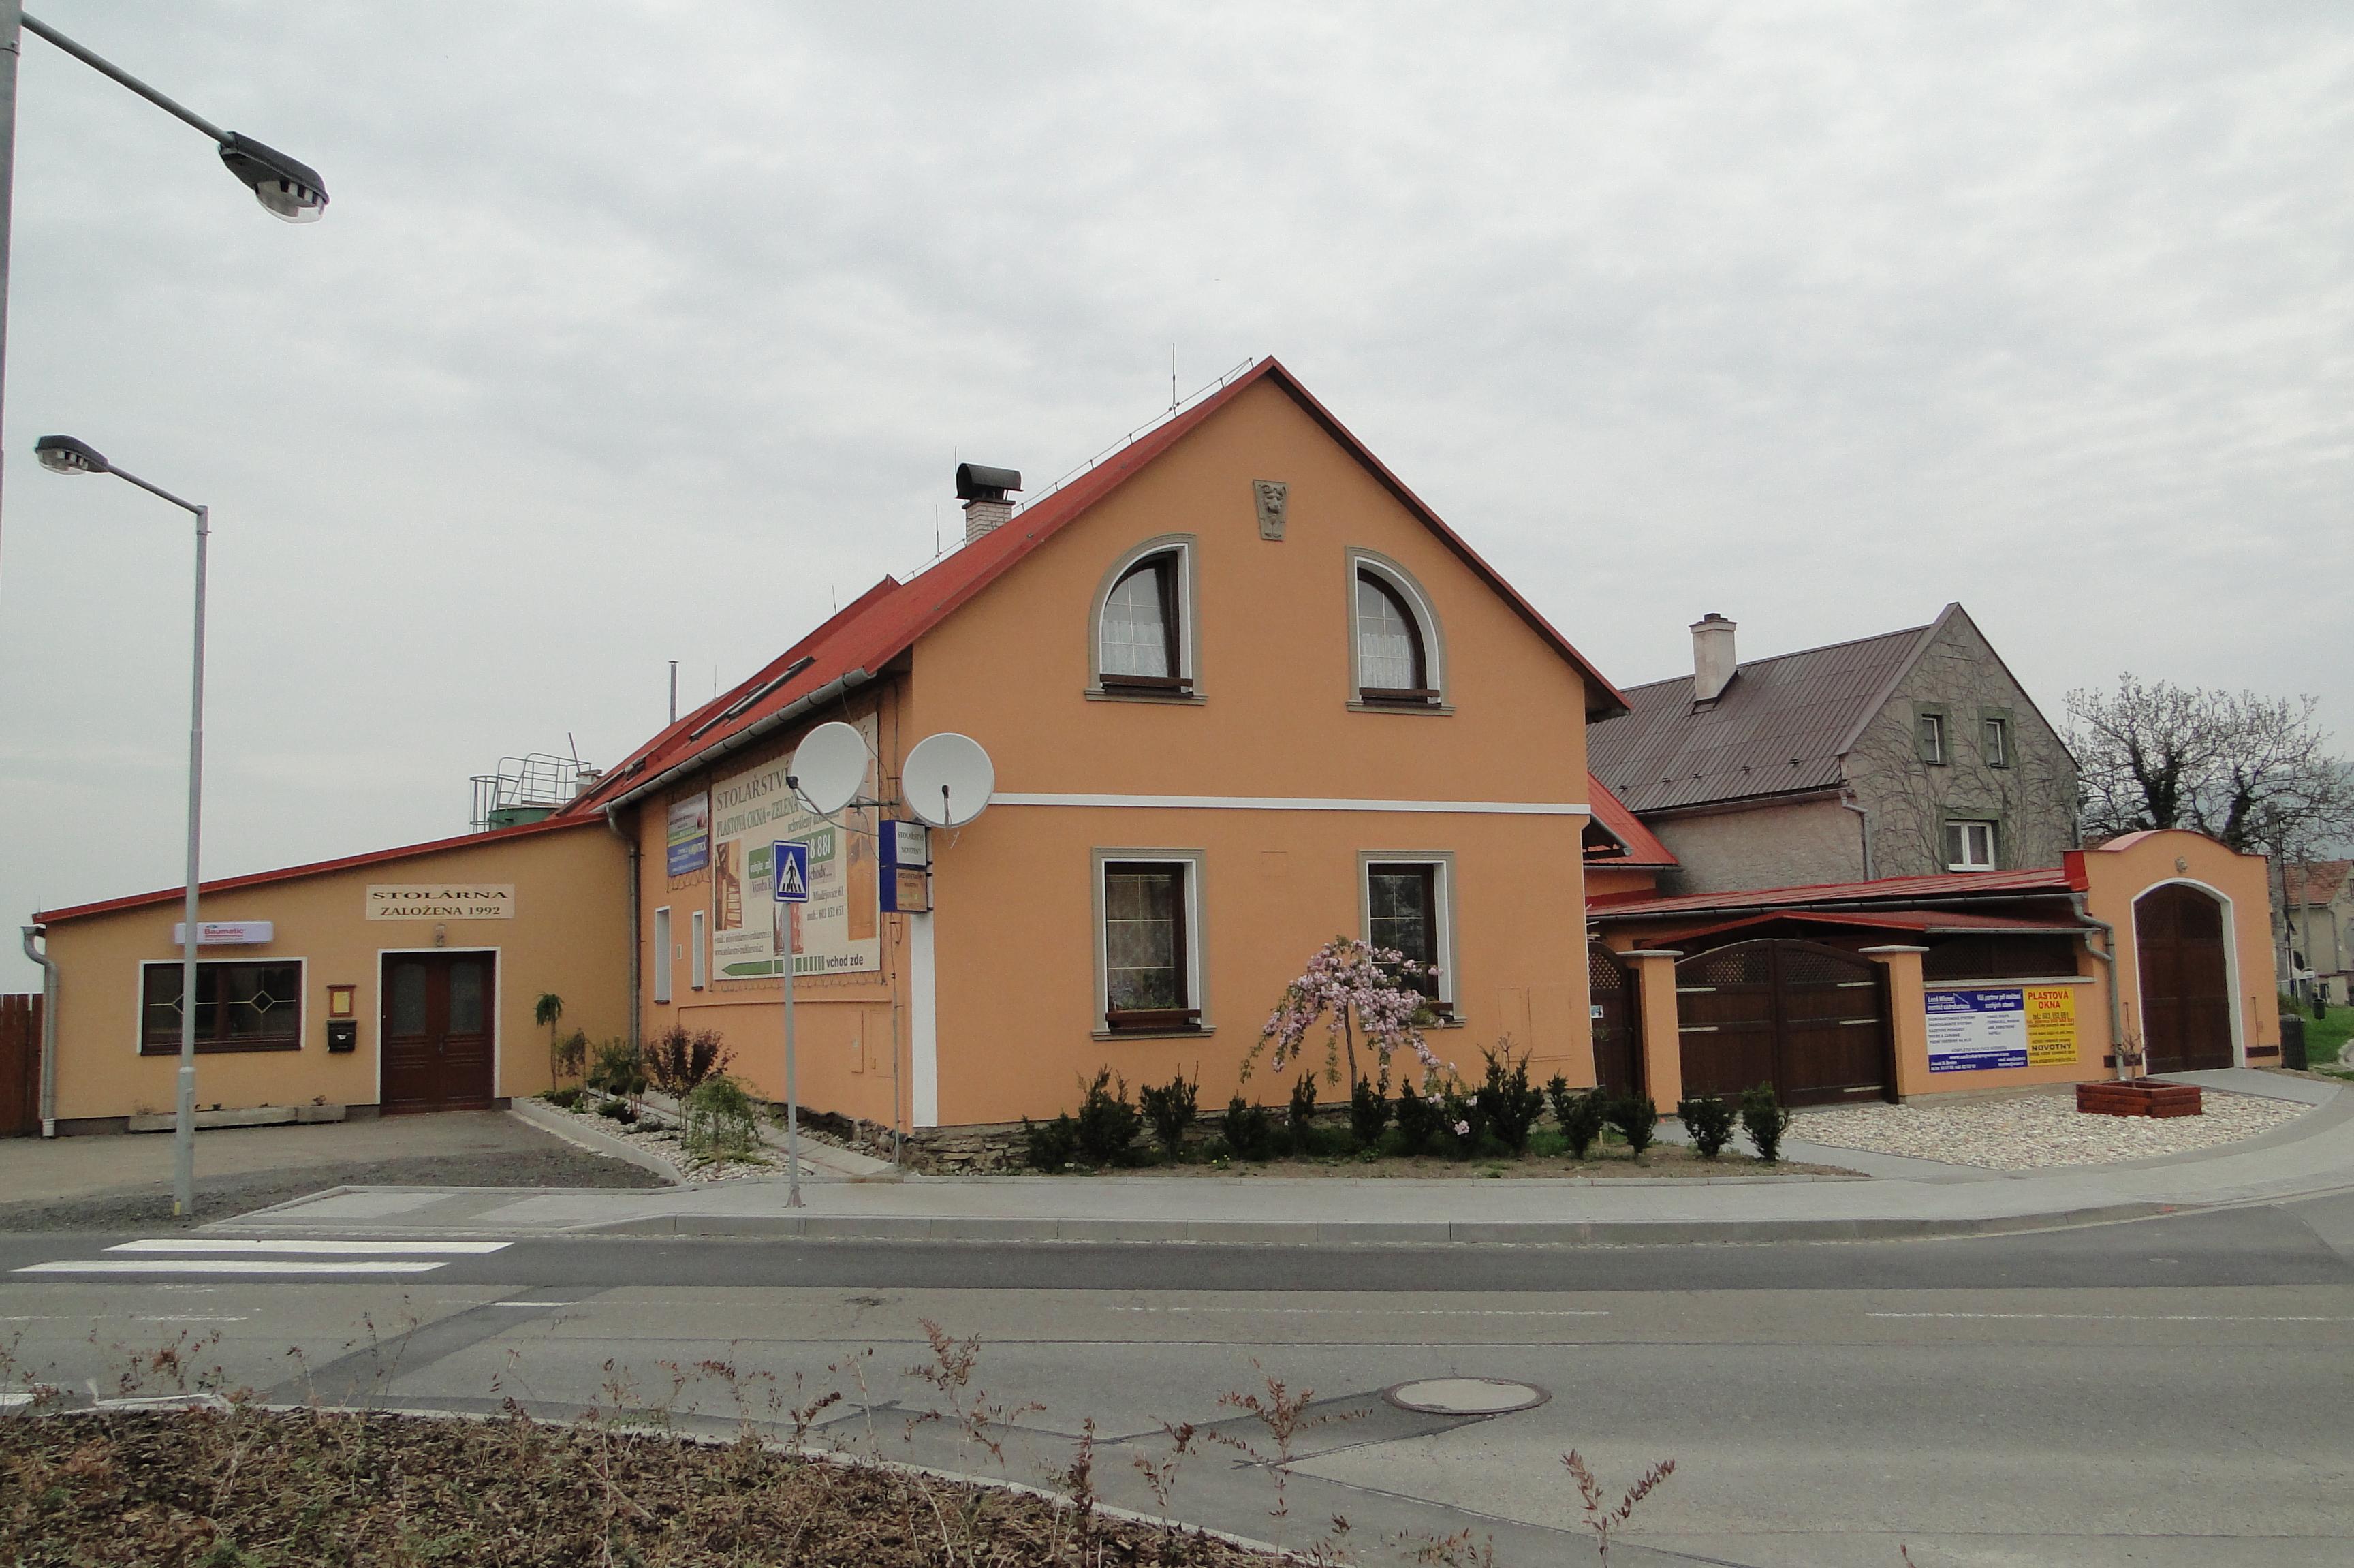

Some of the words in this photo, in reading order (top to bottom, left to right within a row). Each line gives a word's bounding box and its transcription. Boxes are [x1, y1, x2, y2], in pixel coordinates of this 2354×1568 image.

[747, 807, 766, 829] OKNA
[817, 834, 830, 857] 881
[381, 905, 462, 915] ZALOŽENA
[468, 907, 501, 915] 1992
[826, 954, 849, 968] vchod
[850, 953, 864, 967] zde
[2028, 989, 2069, 1000] PLASTOVÁ
[2038, 1001, 2060, 1009] OKNA
